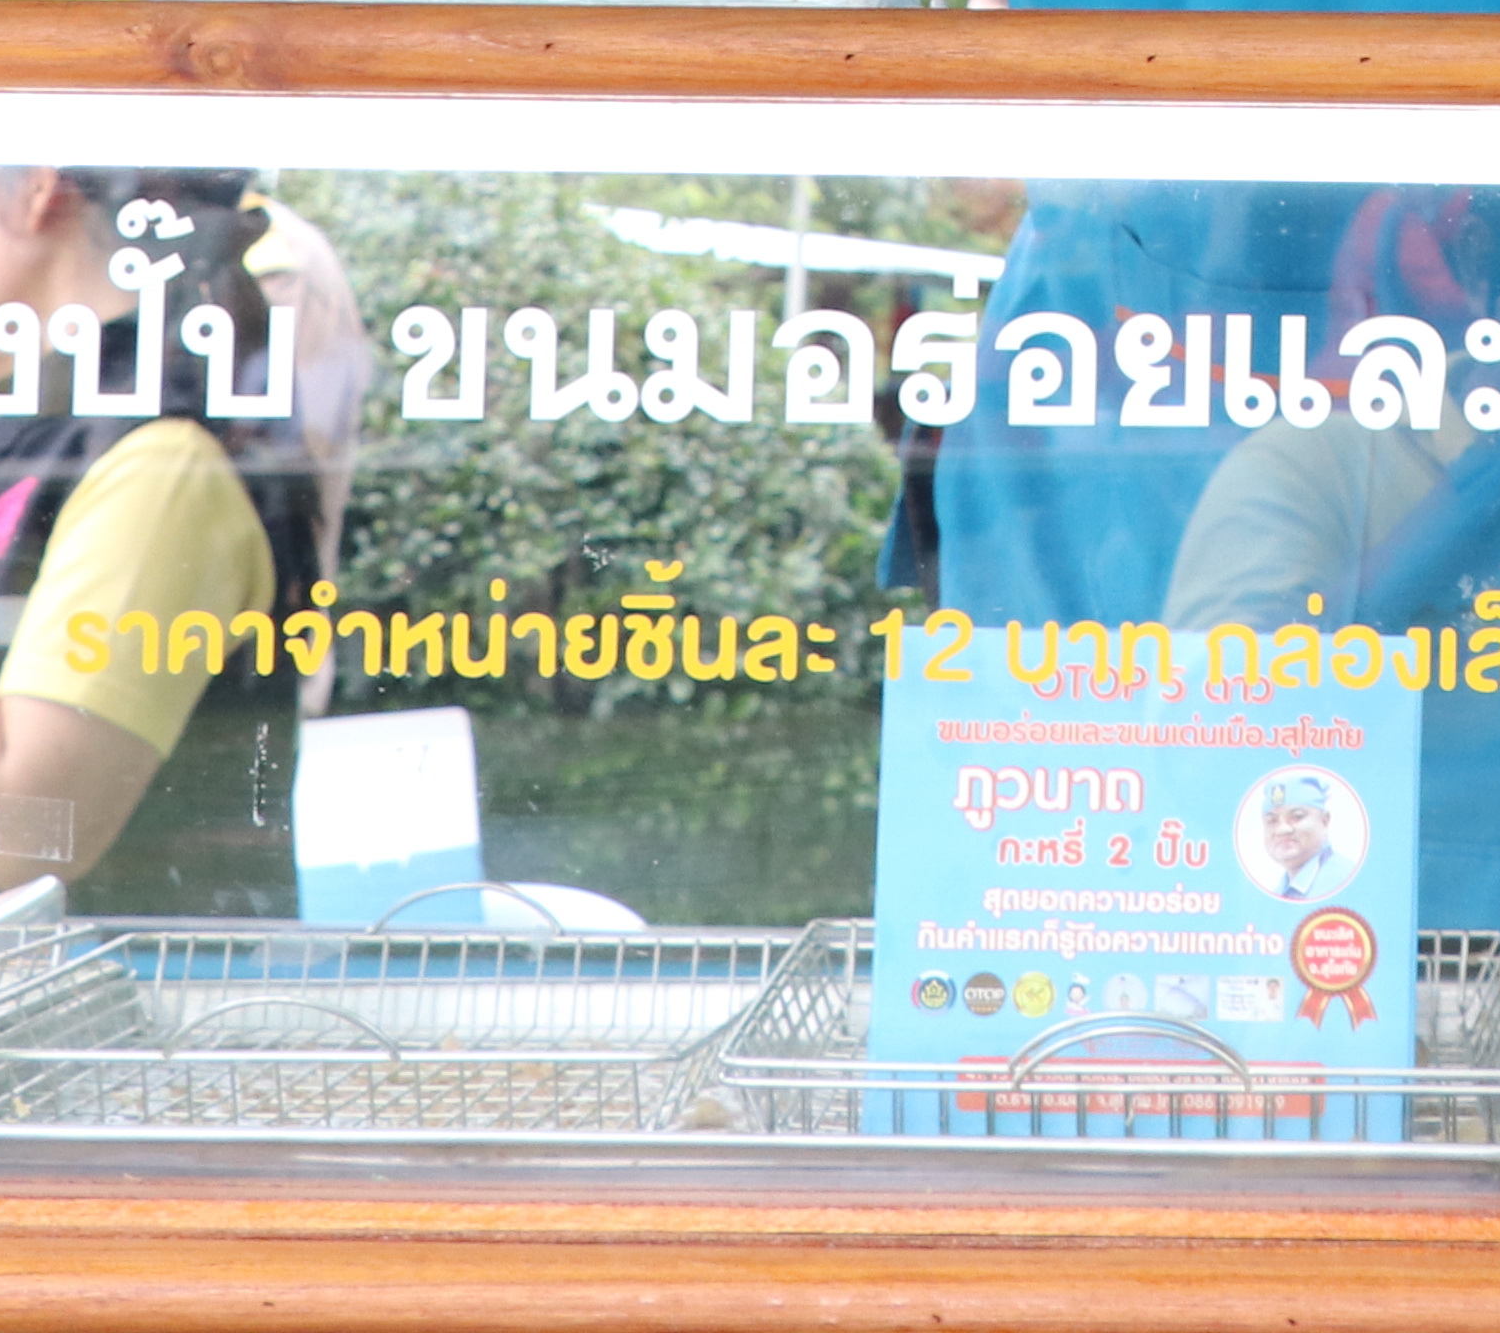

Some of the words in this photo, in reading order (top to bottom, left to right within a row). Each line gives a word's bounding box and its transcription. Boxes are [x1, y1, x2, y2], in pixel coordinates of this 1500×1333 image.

[64, 560, 836, 681] ราคาจำหน่ายชิ้นละ
[870, 609, 973, 681] 12
[1007, 620, 1172, 684] บาท
[953, 764, 1145, 831] ภูวนาถ
[996, 820, 1086, 868] กะหรี่
[1106, 835, 1133, 868] 2
[1153, 819, 1211, 870] ปั๊บ
[982, 883, 1221, 919] สุดยอดความอร่อย
